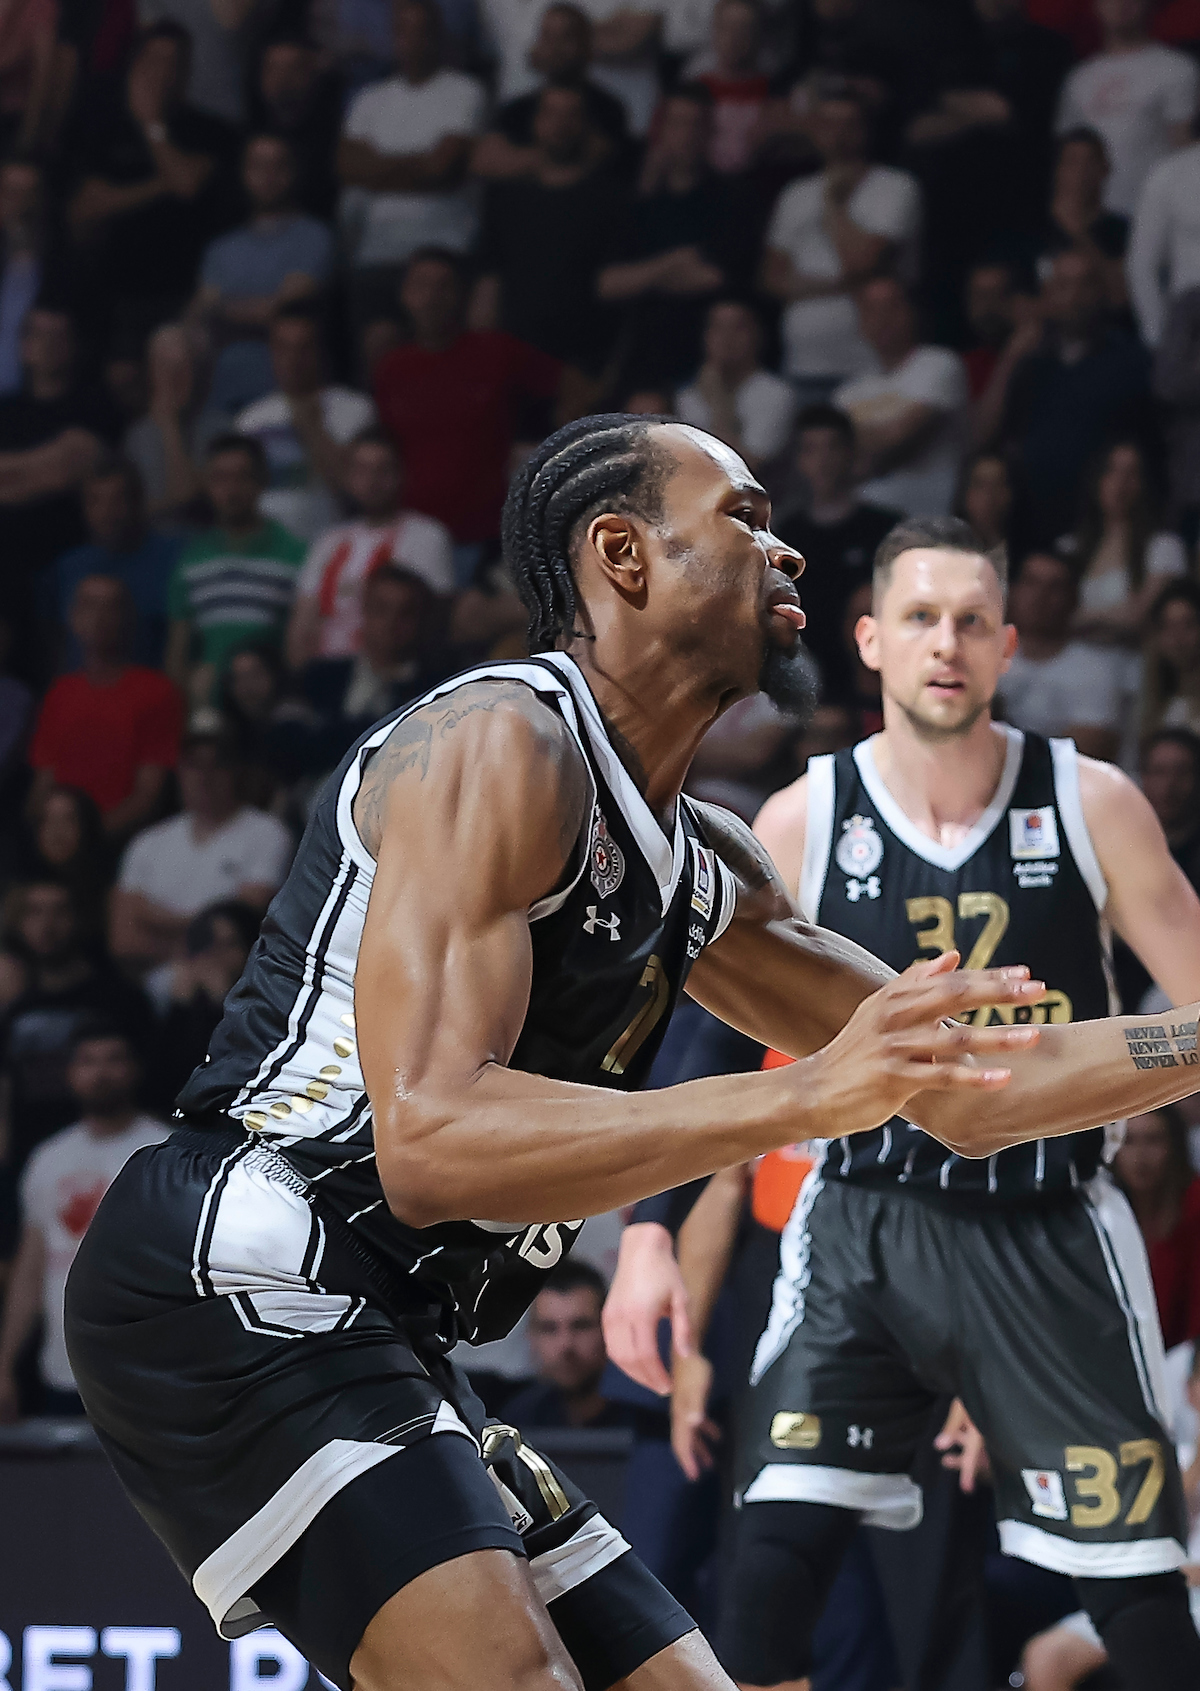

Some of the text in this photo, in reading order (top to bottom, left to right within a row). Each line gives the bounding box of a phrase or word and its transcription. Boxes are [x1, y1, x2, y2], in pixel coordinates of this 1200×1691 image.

[906, 891, 1010, 970] 37
[1065, 1438, 1165, 1529] 37
[0, 1625, 182, 1691] ET
